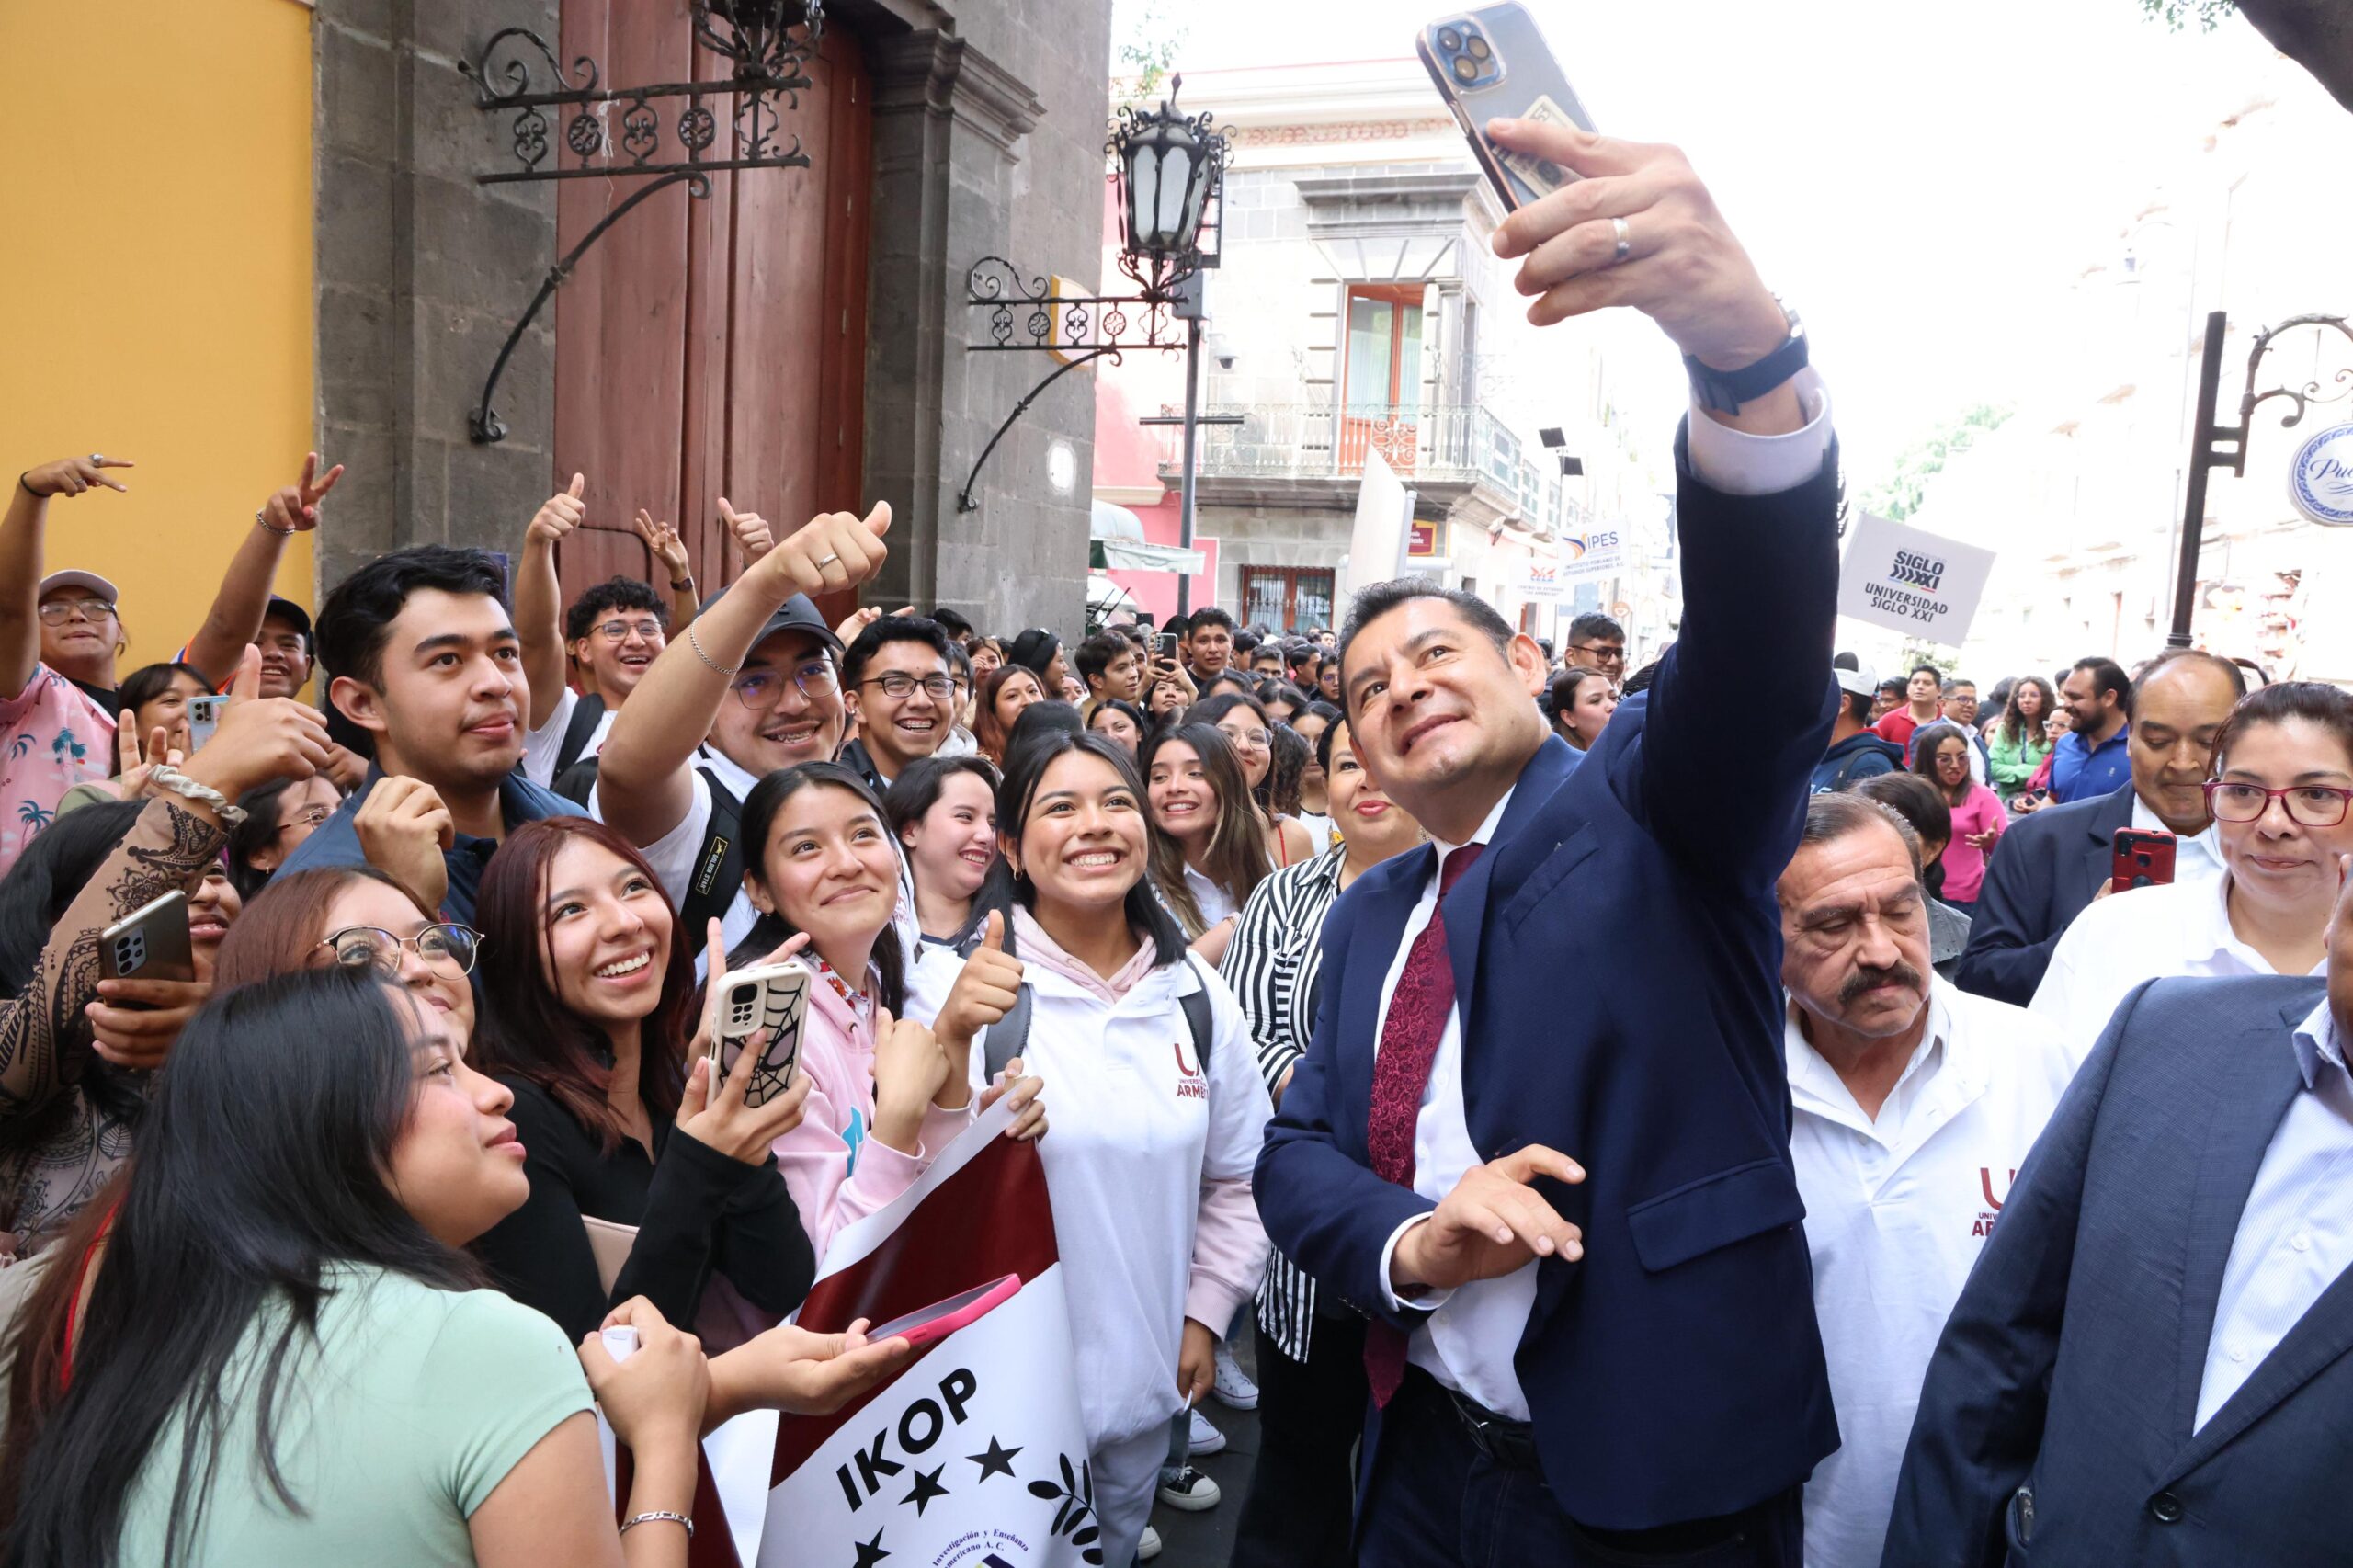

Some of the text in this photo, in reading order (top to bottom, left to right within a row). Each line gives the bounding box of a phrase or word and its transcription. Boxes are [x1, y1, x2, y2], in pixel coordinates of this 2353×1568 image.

[1587, 531, 1619, 550] IPES
[1894, 551, 1945, 575] SIGLO
[1865, 582, 1949, 615] UNIVERSIDAD
[1870, 597, 1934, 623] SIGLO XXI
[706, 853, 719, 874] GOLDEN
[836, 1368, 977, 1513] IKOP
[932, 1528, 1029, 1567] Investigación y Enseñanza
